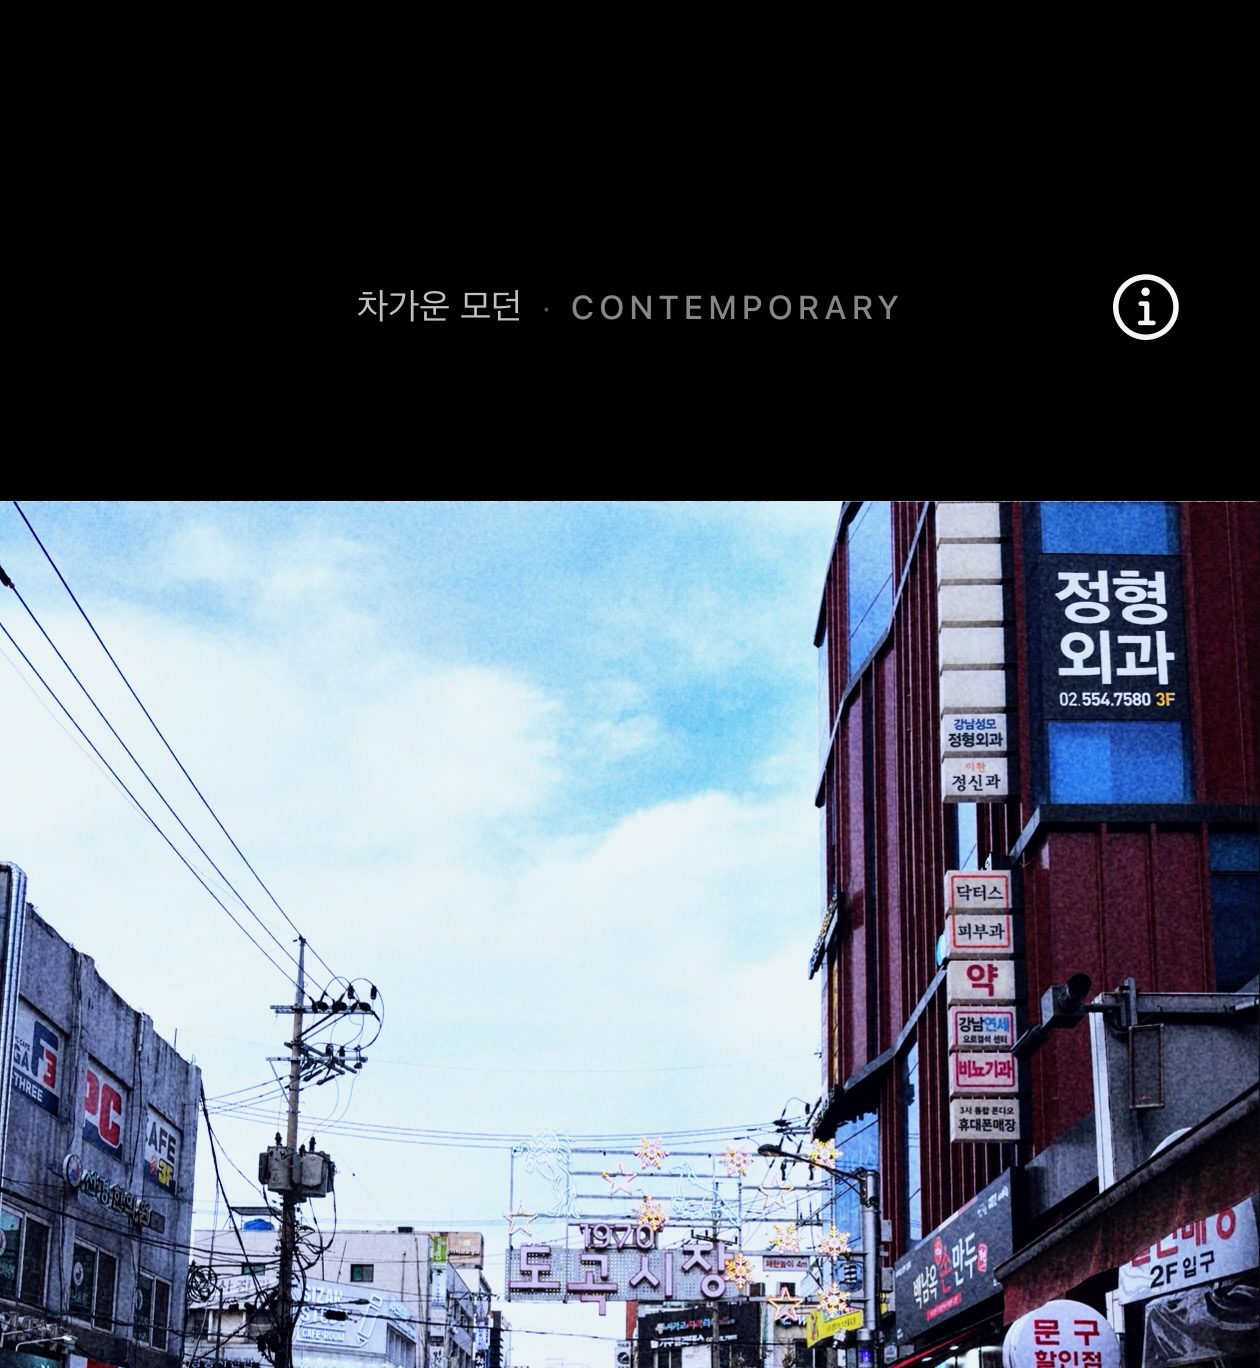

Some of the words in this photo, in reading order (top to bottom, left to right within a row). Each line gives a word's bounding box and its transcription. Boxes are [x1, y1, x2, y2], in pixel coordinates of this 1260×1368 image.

[1055, 570, 1168, 625] 정형
[1058, 630, 1175, 685] 외과
[1059, 691, 1151, 707] 02.554.7580
[1155, 691, 1175, 707] 3F
[954, 718, 996, 731] 강남성모
[948, 732, 1003, 748] 정형외과
[952, 774, 1001, 791] 정신과
[956, 884, 1004, 901] 닥터스
[957, 923, 1005, 940] 피부과
[966, 963, 998, 997] 약
[959, 1016, 1009, 1032] 강남연세
[958, 1060, 1012, 1078] 비뇨기과
[958, 1118, 1016, 1133] 휴대폰매장
[147, 1121, 176, 1164] AFE
[580, 1222, 655, 1250] 1970
[1150, 1261, 1178, 1288] 2F
[1183, 1250, 1215, 1279] 입구
[508, 1241, 735, 1316] 도곡시장
